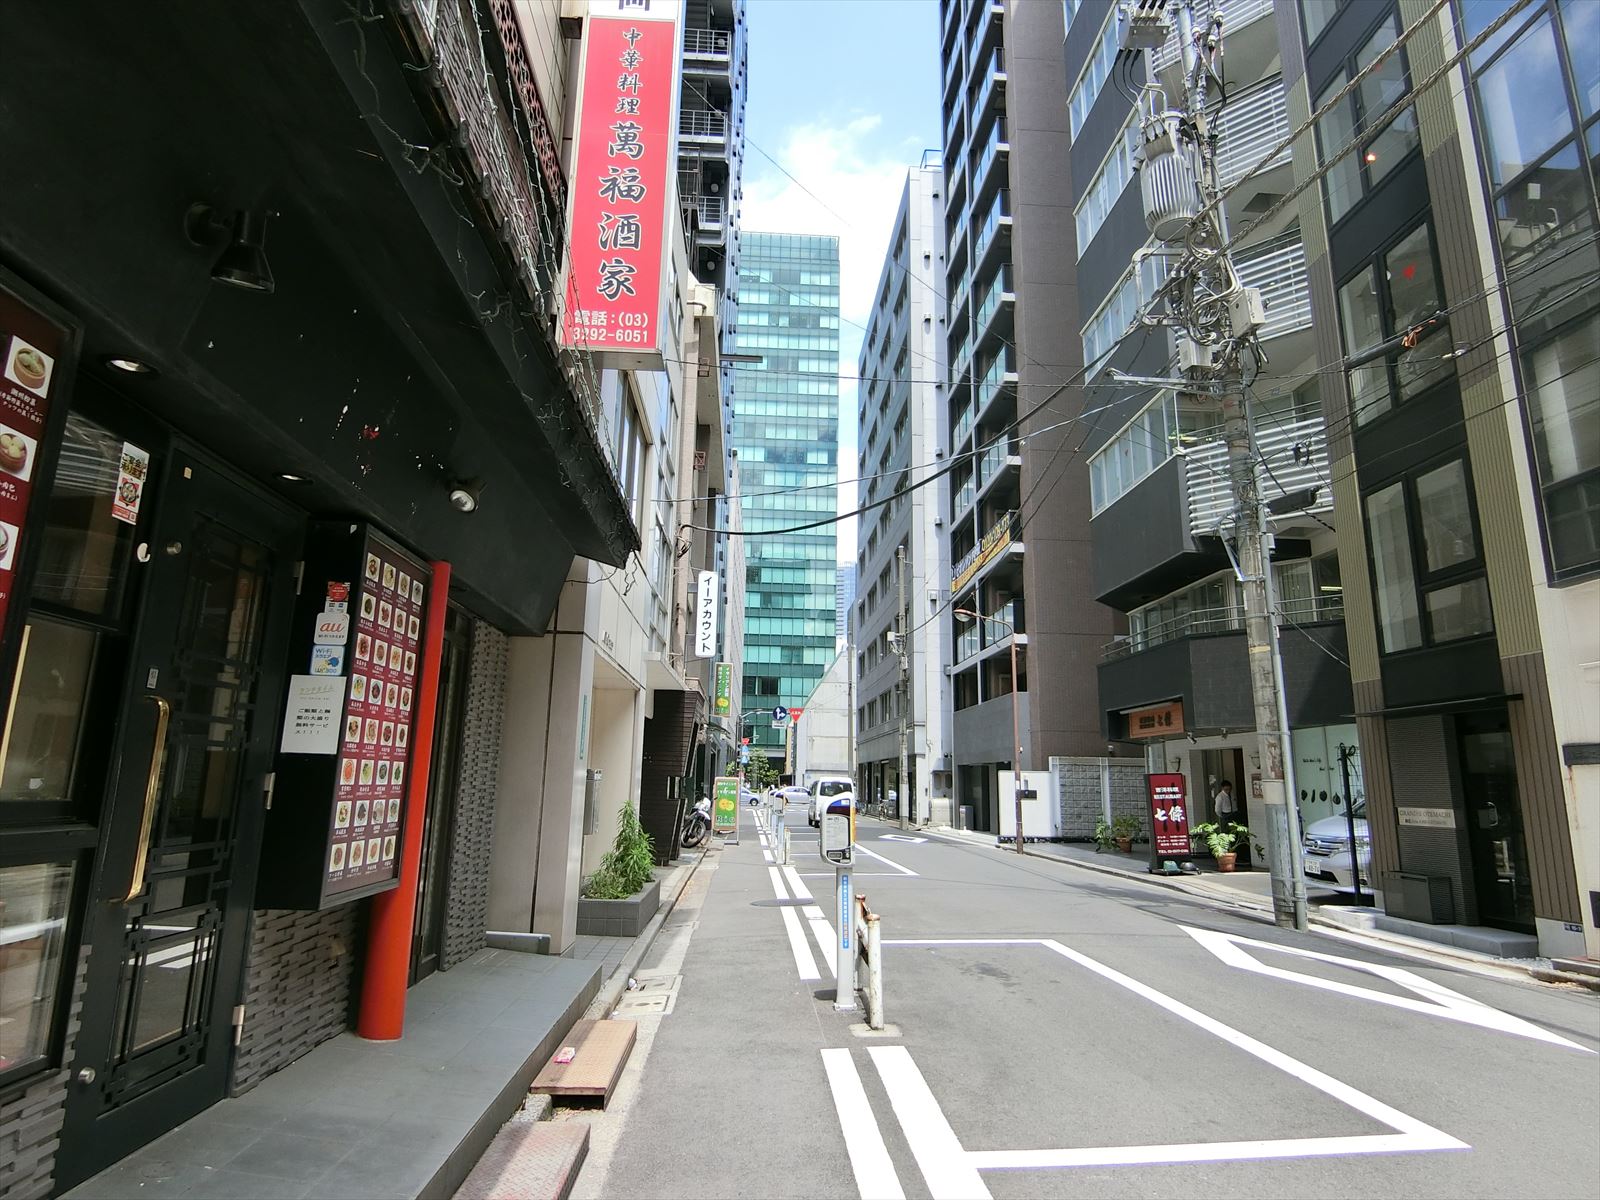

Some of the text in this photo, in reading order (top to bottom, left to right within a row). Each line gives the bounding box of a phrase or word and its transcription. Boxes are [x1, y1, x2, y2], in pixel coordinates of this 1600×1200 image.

[616, 27, 644, 116] 中華料理
[597, 121, 647, 301] 萬福酒家
[573, 327, 648, 343] 3292-6051
[320, 622, 345, 633] au
[702, 576, 713, 653] イーアカウント
